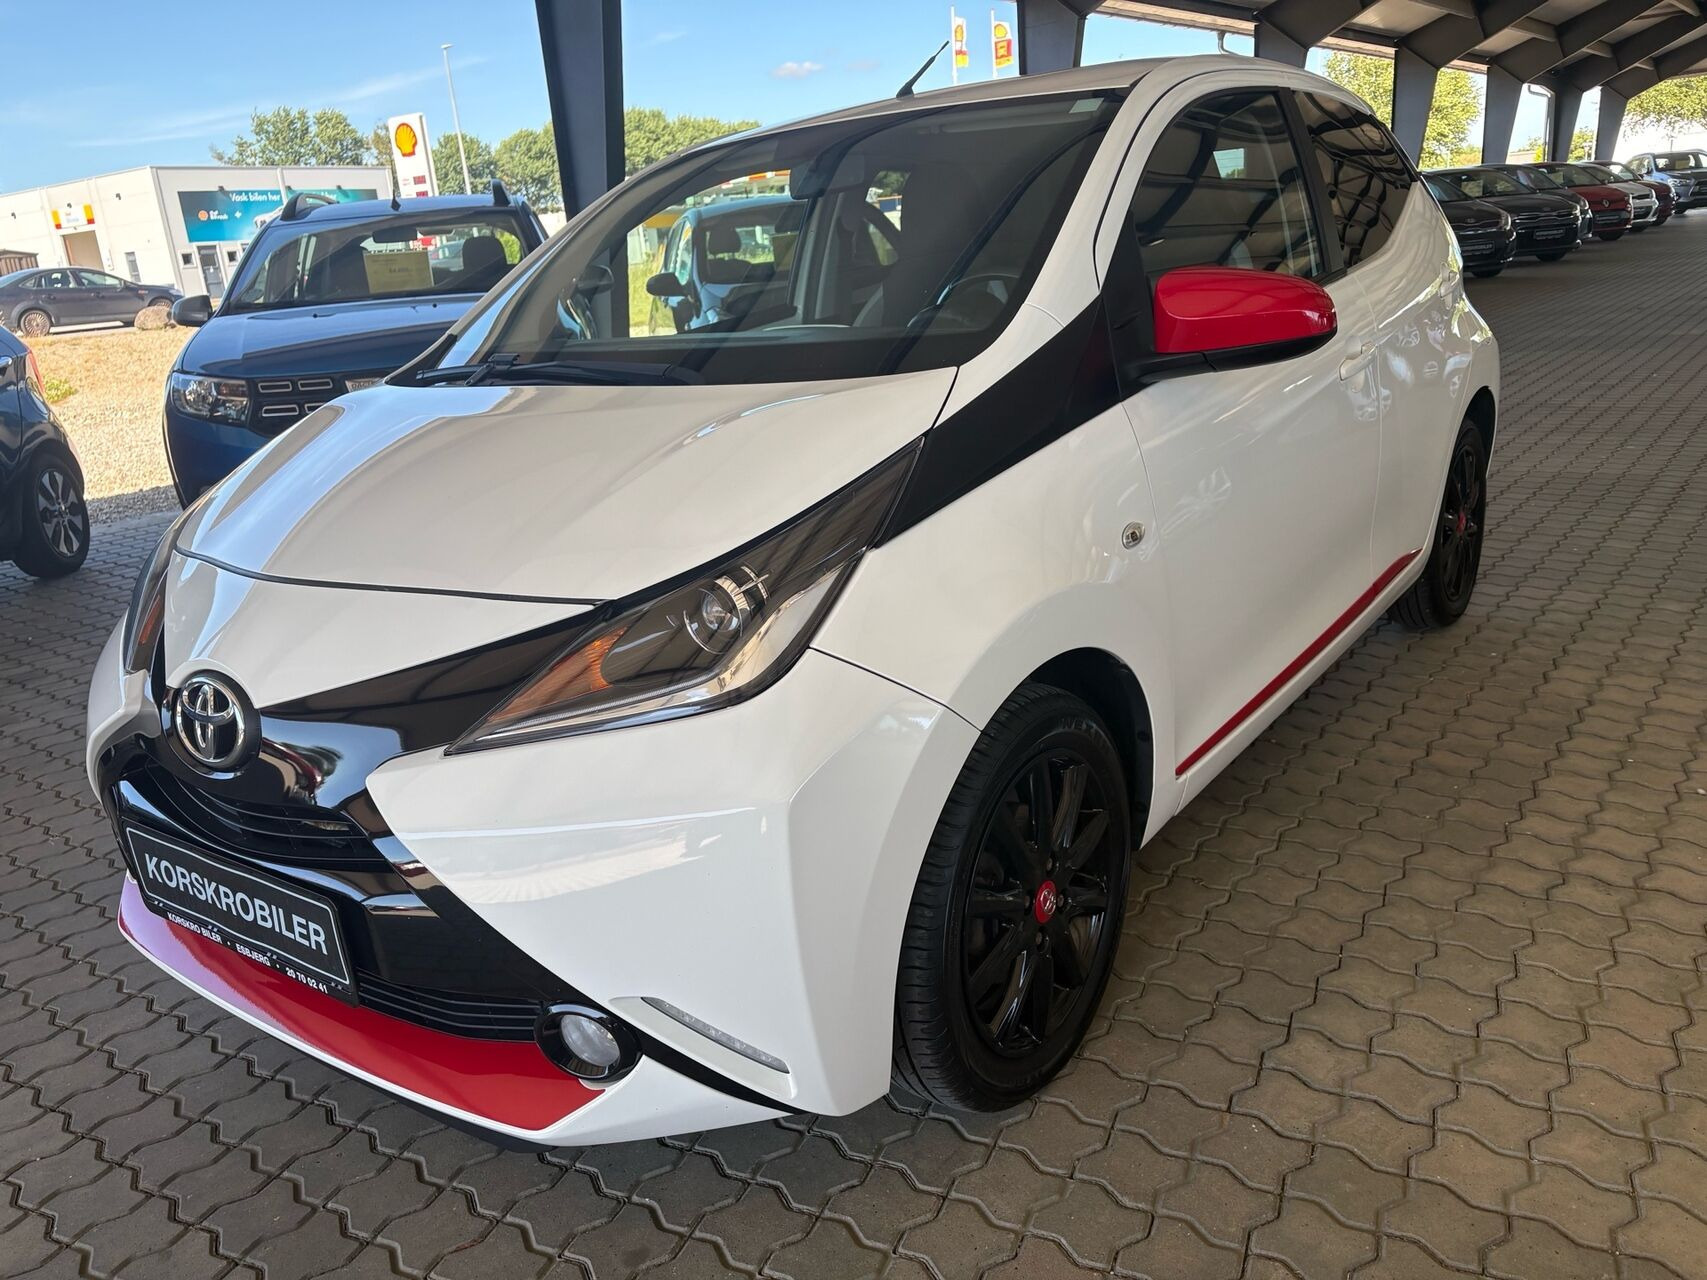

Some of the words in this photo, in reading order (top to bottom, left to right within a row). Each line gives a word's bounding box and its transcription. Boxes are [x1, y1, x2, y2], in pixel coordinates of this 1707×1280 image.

[230, 192, 249, 202] Vask
[249, 192, 268, 201] bilen
[145, 853, 328, 955] KORSKROBILER
[167, 912, 201, 934] KORSKRO
[201, 927, 223, 944] BILER
[235, 943, 271, 967] ESBJERG
[286, 967, 296, 979] 20
[296, 971, 307, 984] 70
[307, 977, 318, 989] 02
[318, 982, 328, 994] 41
